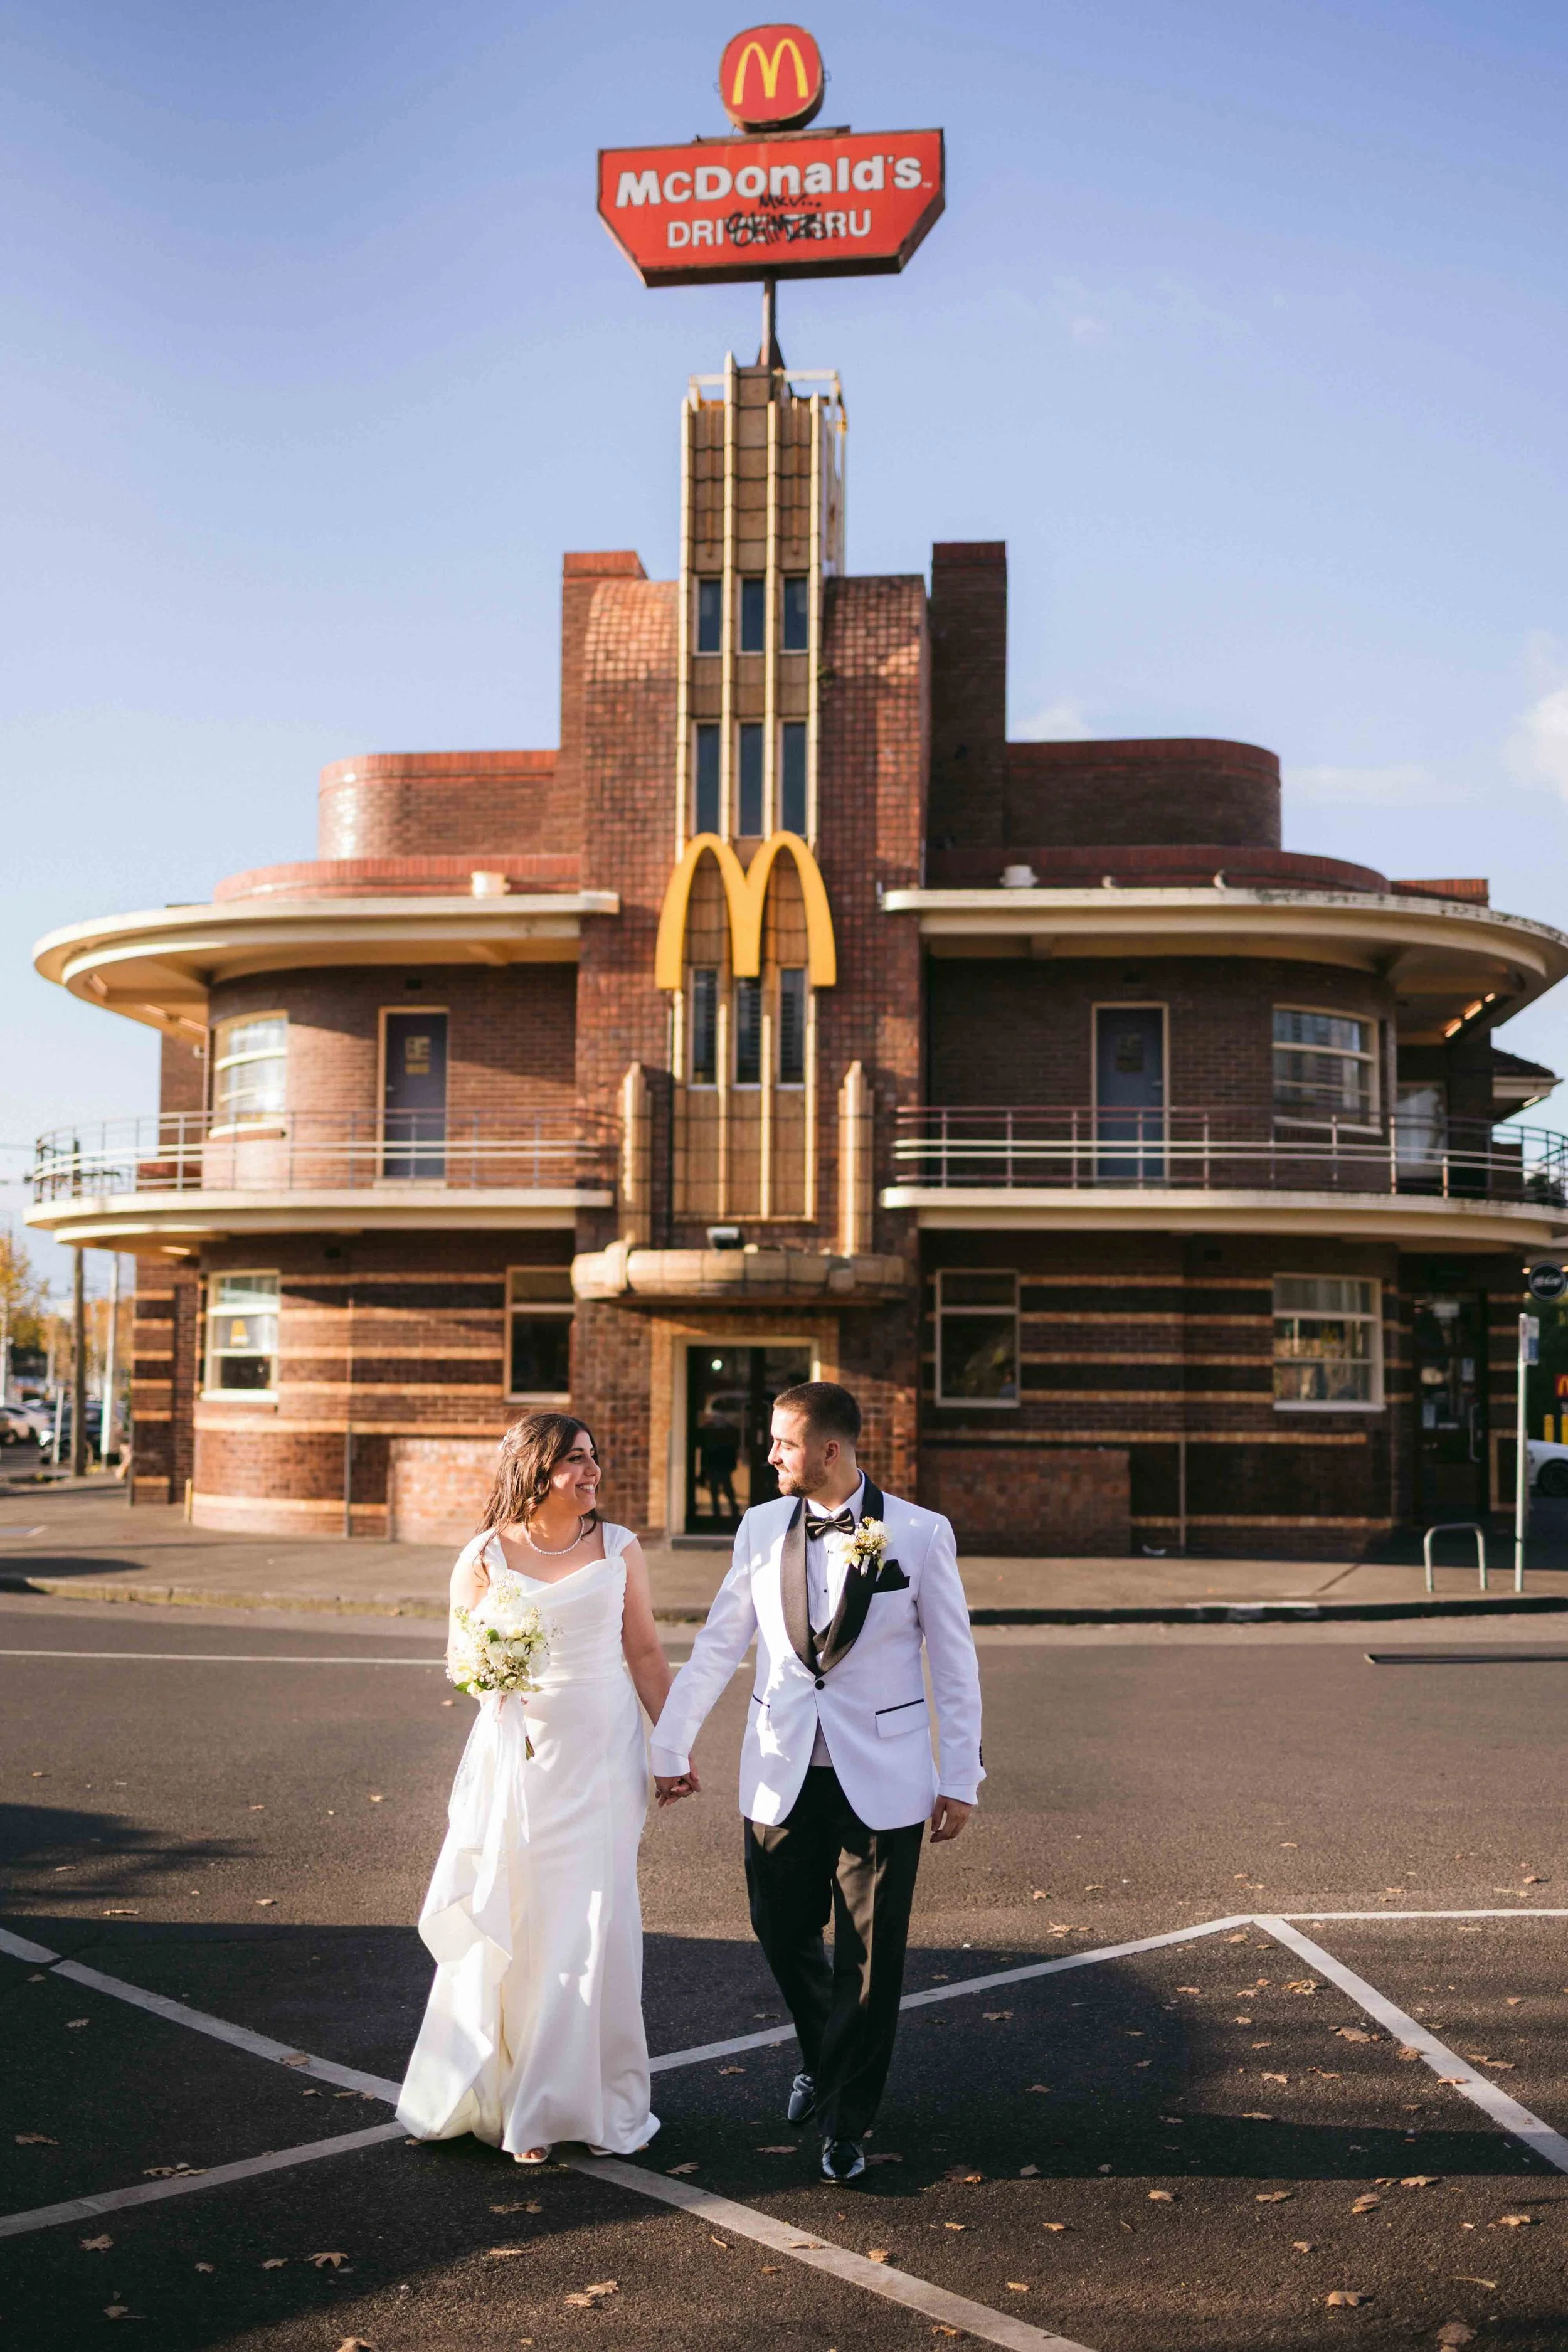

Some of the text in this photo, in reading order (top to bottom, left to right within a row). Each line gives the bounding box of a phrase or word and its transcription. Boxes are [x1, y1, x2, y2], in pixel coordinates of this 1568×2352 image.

[731, 38, 809, 106] M
[615, 154, 923, 209] McDonald's
[654, 830, 837, 990] M
